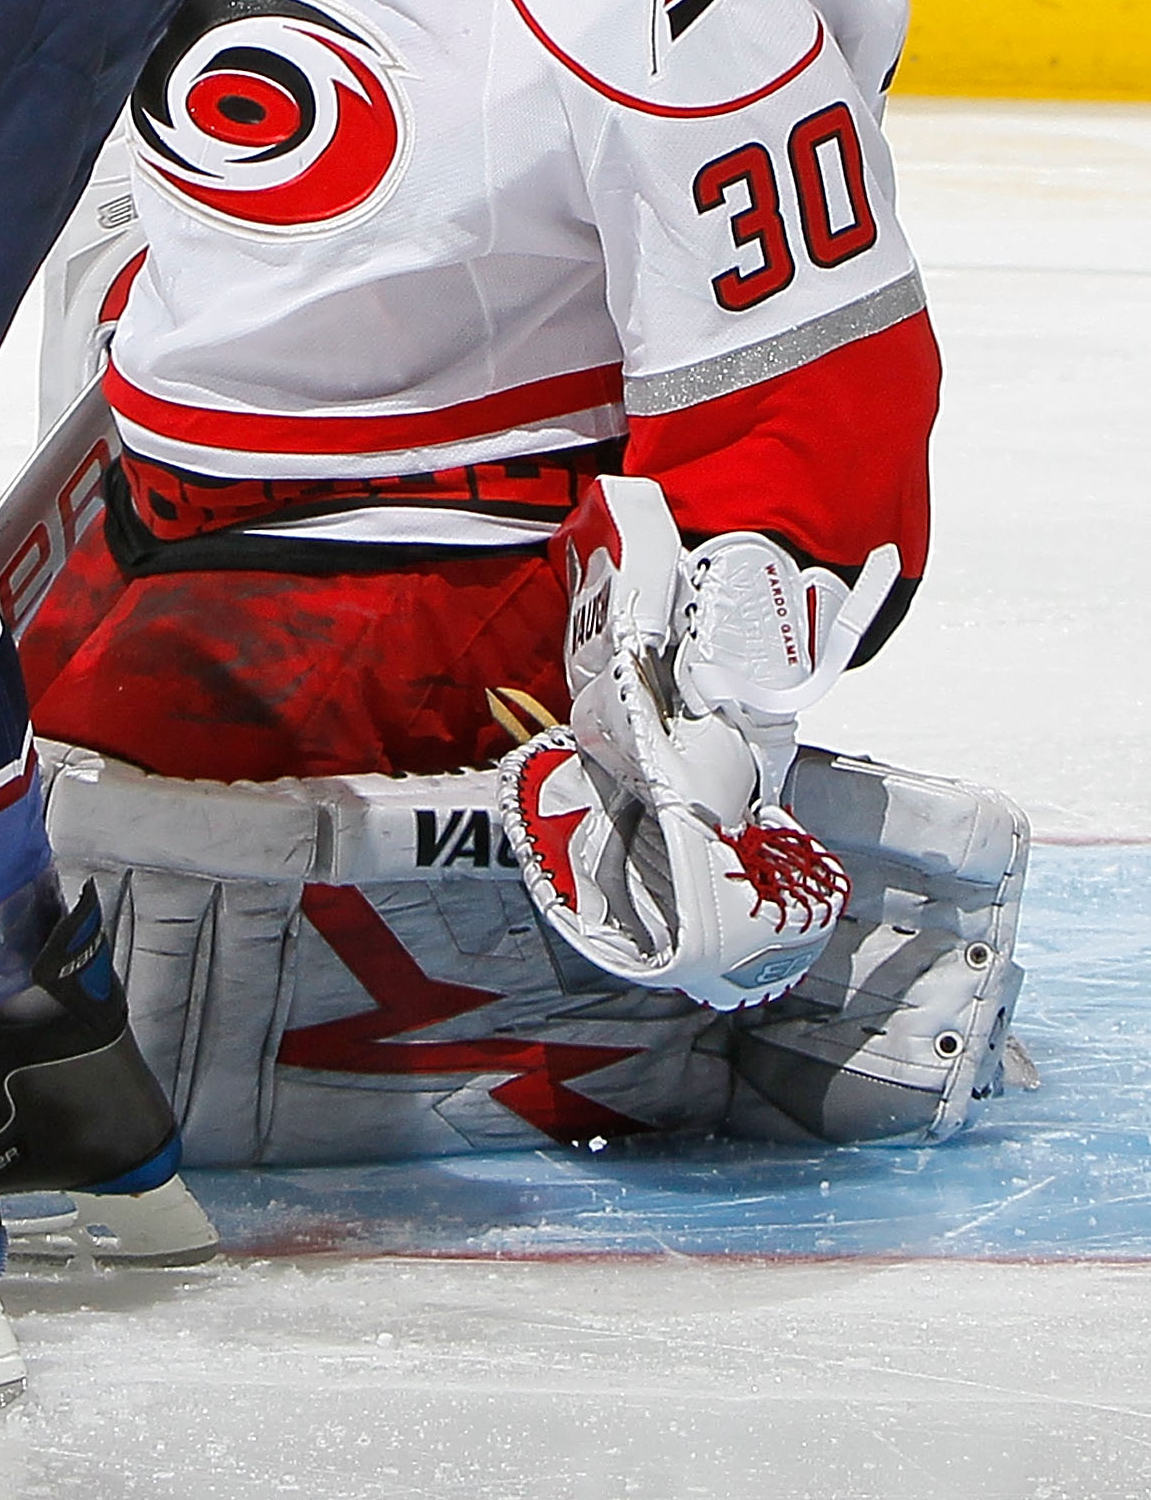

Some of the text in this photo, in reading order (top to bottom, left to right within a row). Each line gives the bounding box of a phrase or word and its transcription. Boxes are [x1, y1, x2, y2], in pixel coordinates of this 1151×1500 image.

[692, 100, 878, 313] 30
[765, 562, 799, 666] WARDO GAME
